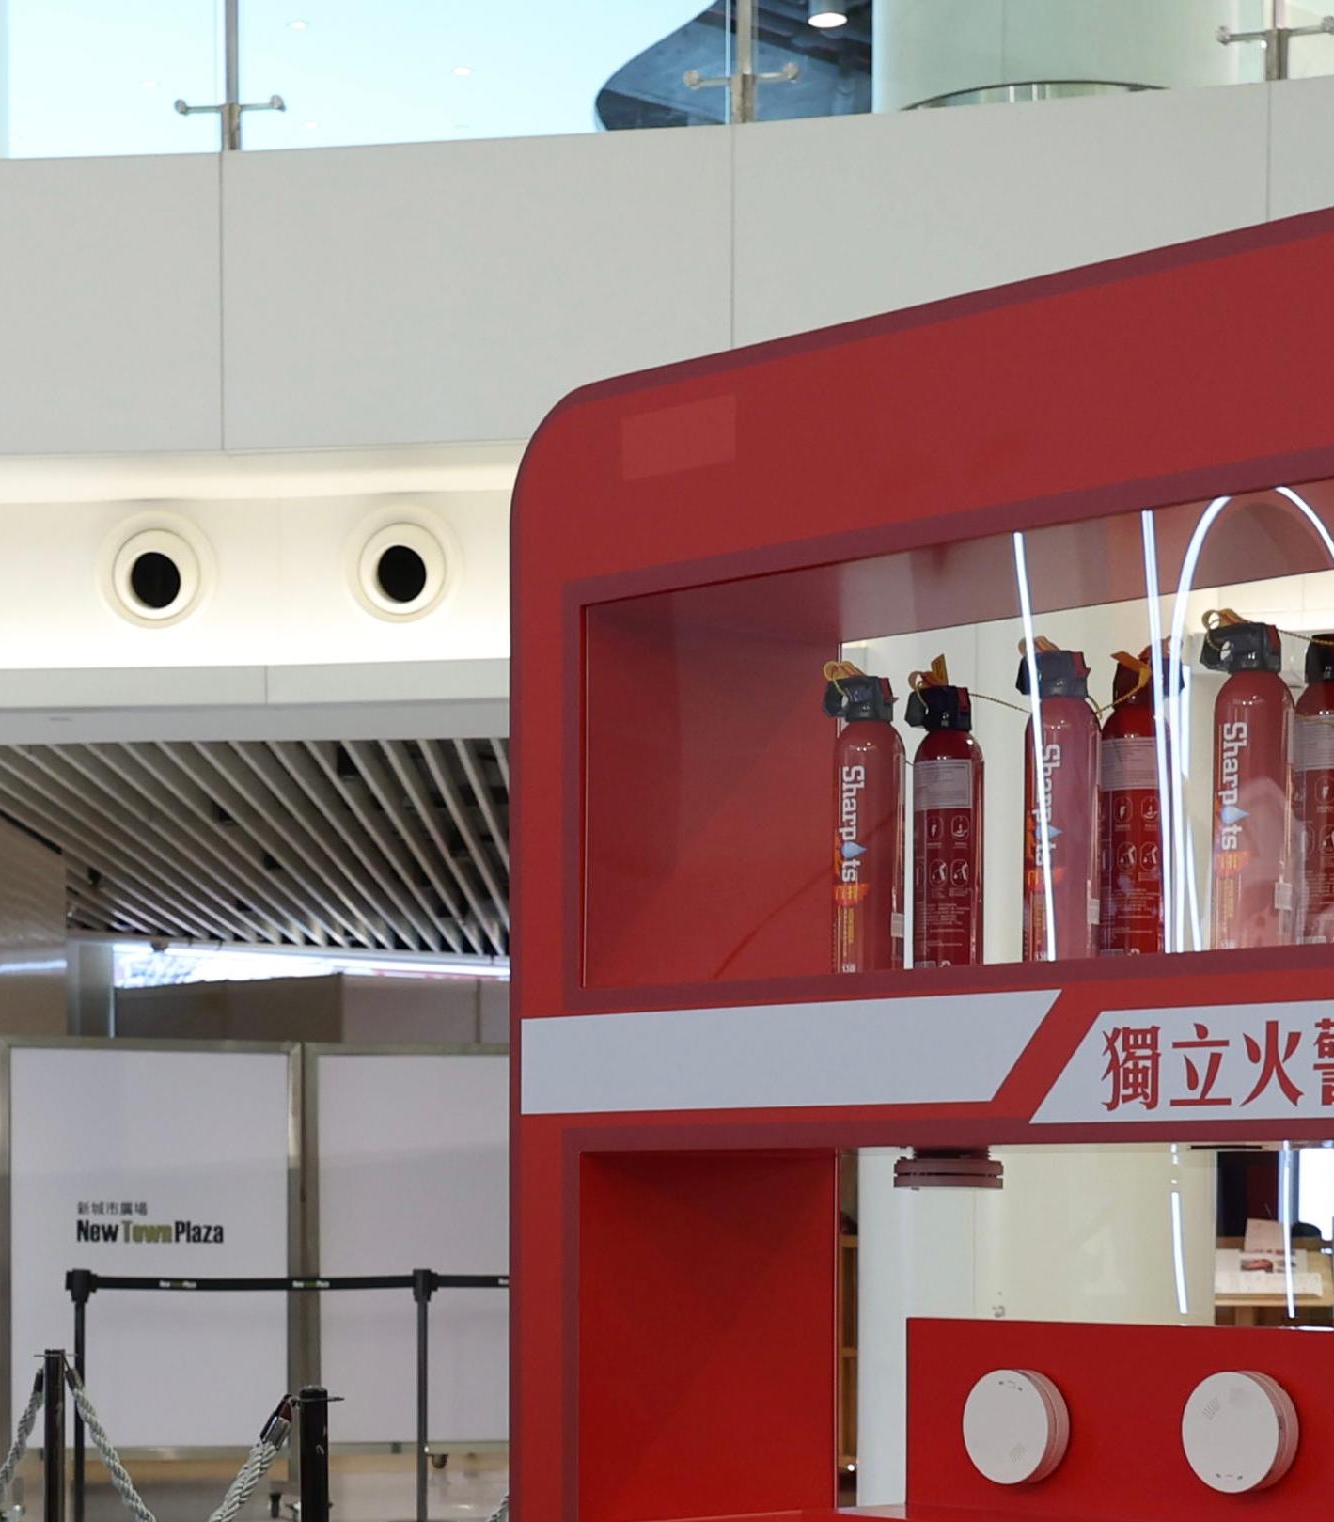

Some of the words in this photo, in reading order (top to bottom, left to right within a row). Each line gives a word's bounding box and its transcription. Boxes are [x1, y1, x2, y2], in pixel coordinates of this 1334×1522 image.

[76, 1219, 118, 1243] New
[121, 1220, 173, 1243] Town
[174, 1221, 224, 1243] Plaza
